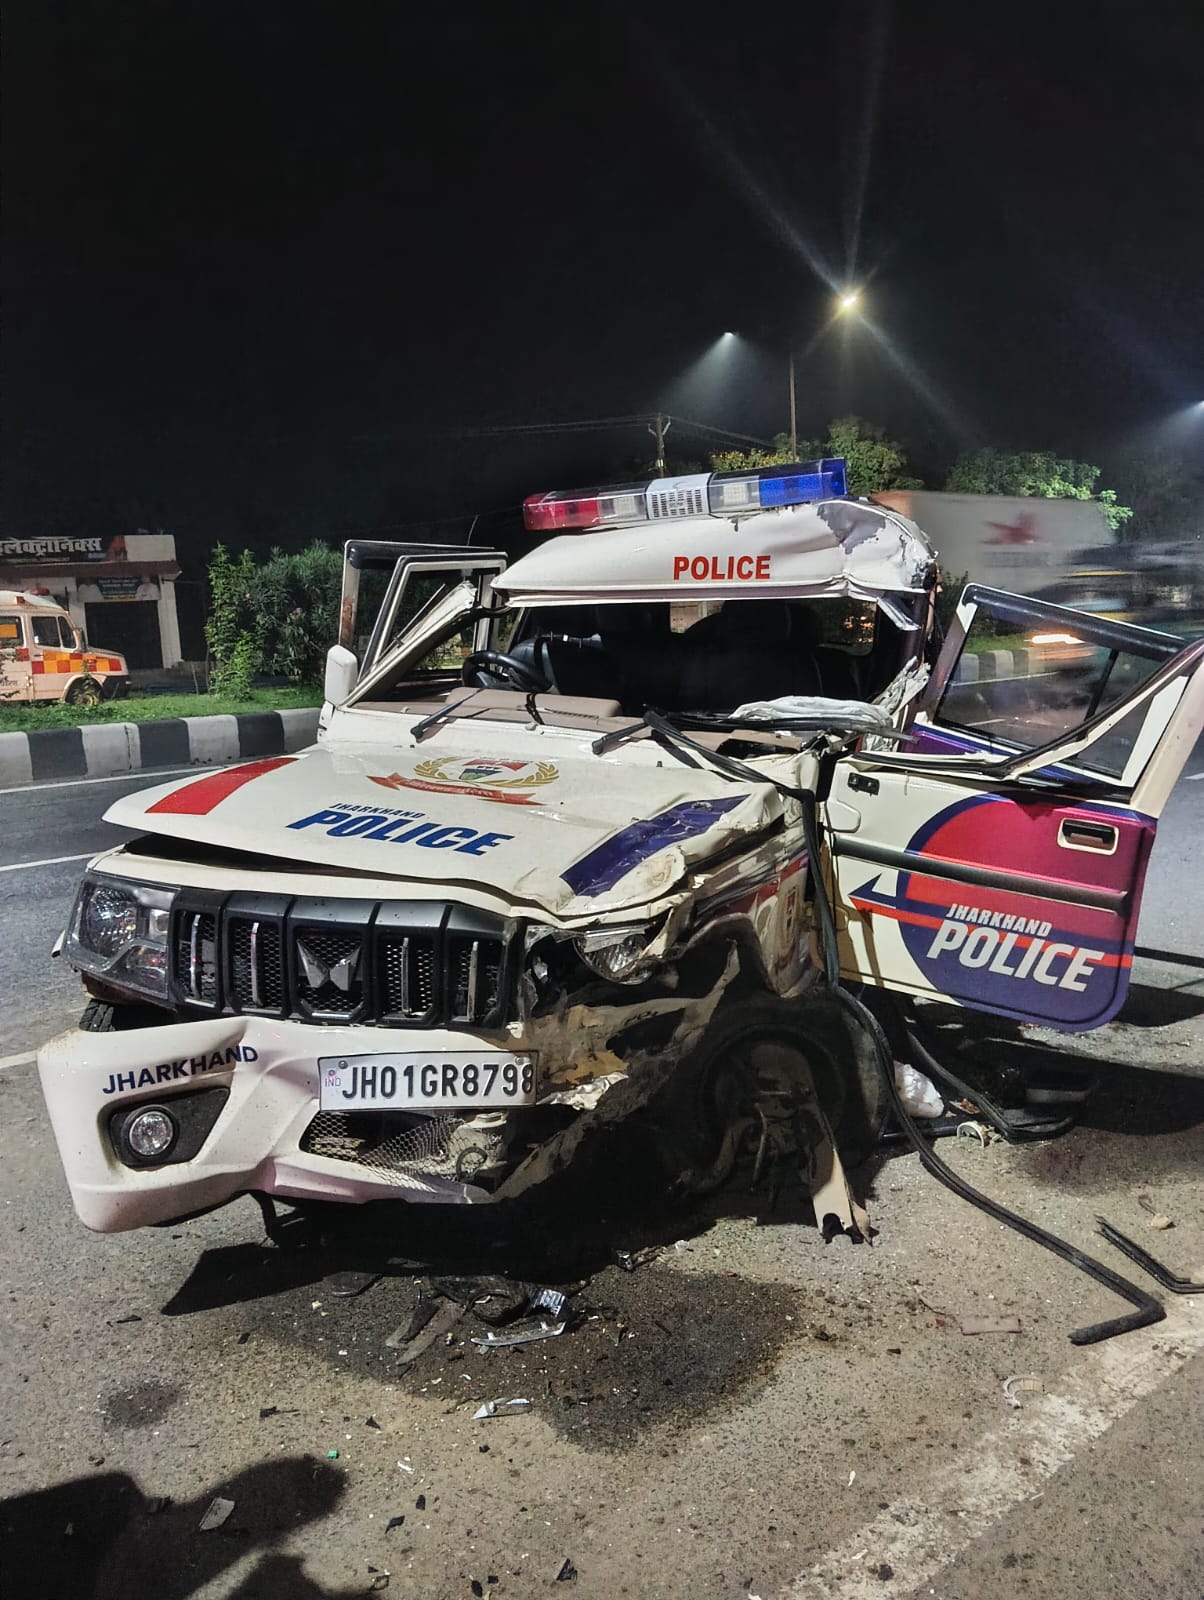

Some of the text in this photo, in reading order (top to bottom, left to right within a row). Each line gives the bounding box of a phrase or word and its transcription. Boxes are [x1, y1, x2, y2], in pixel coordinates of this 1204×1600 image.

[673, 555, 771, 580] POLICE
[328, 803, 426, 818] JHARKHAND
[285, 809, 515, 856] POLICE
[946, 903, 1053, 937] JHARKHAND
[926, 919, 1105, 993] POLICE
[102, 1045, 258, 1094] JHARKHAND
[342, 1063, 534, 1099] JH01GR8798
